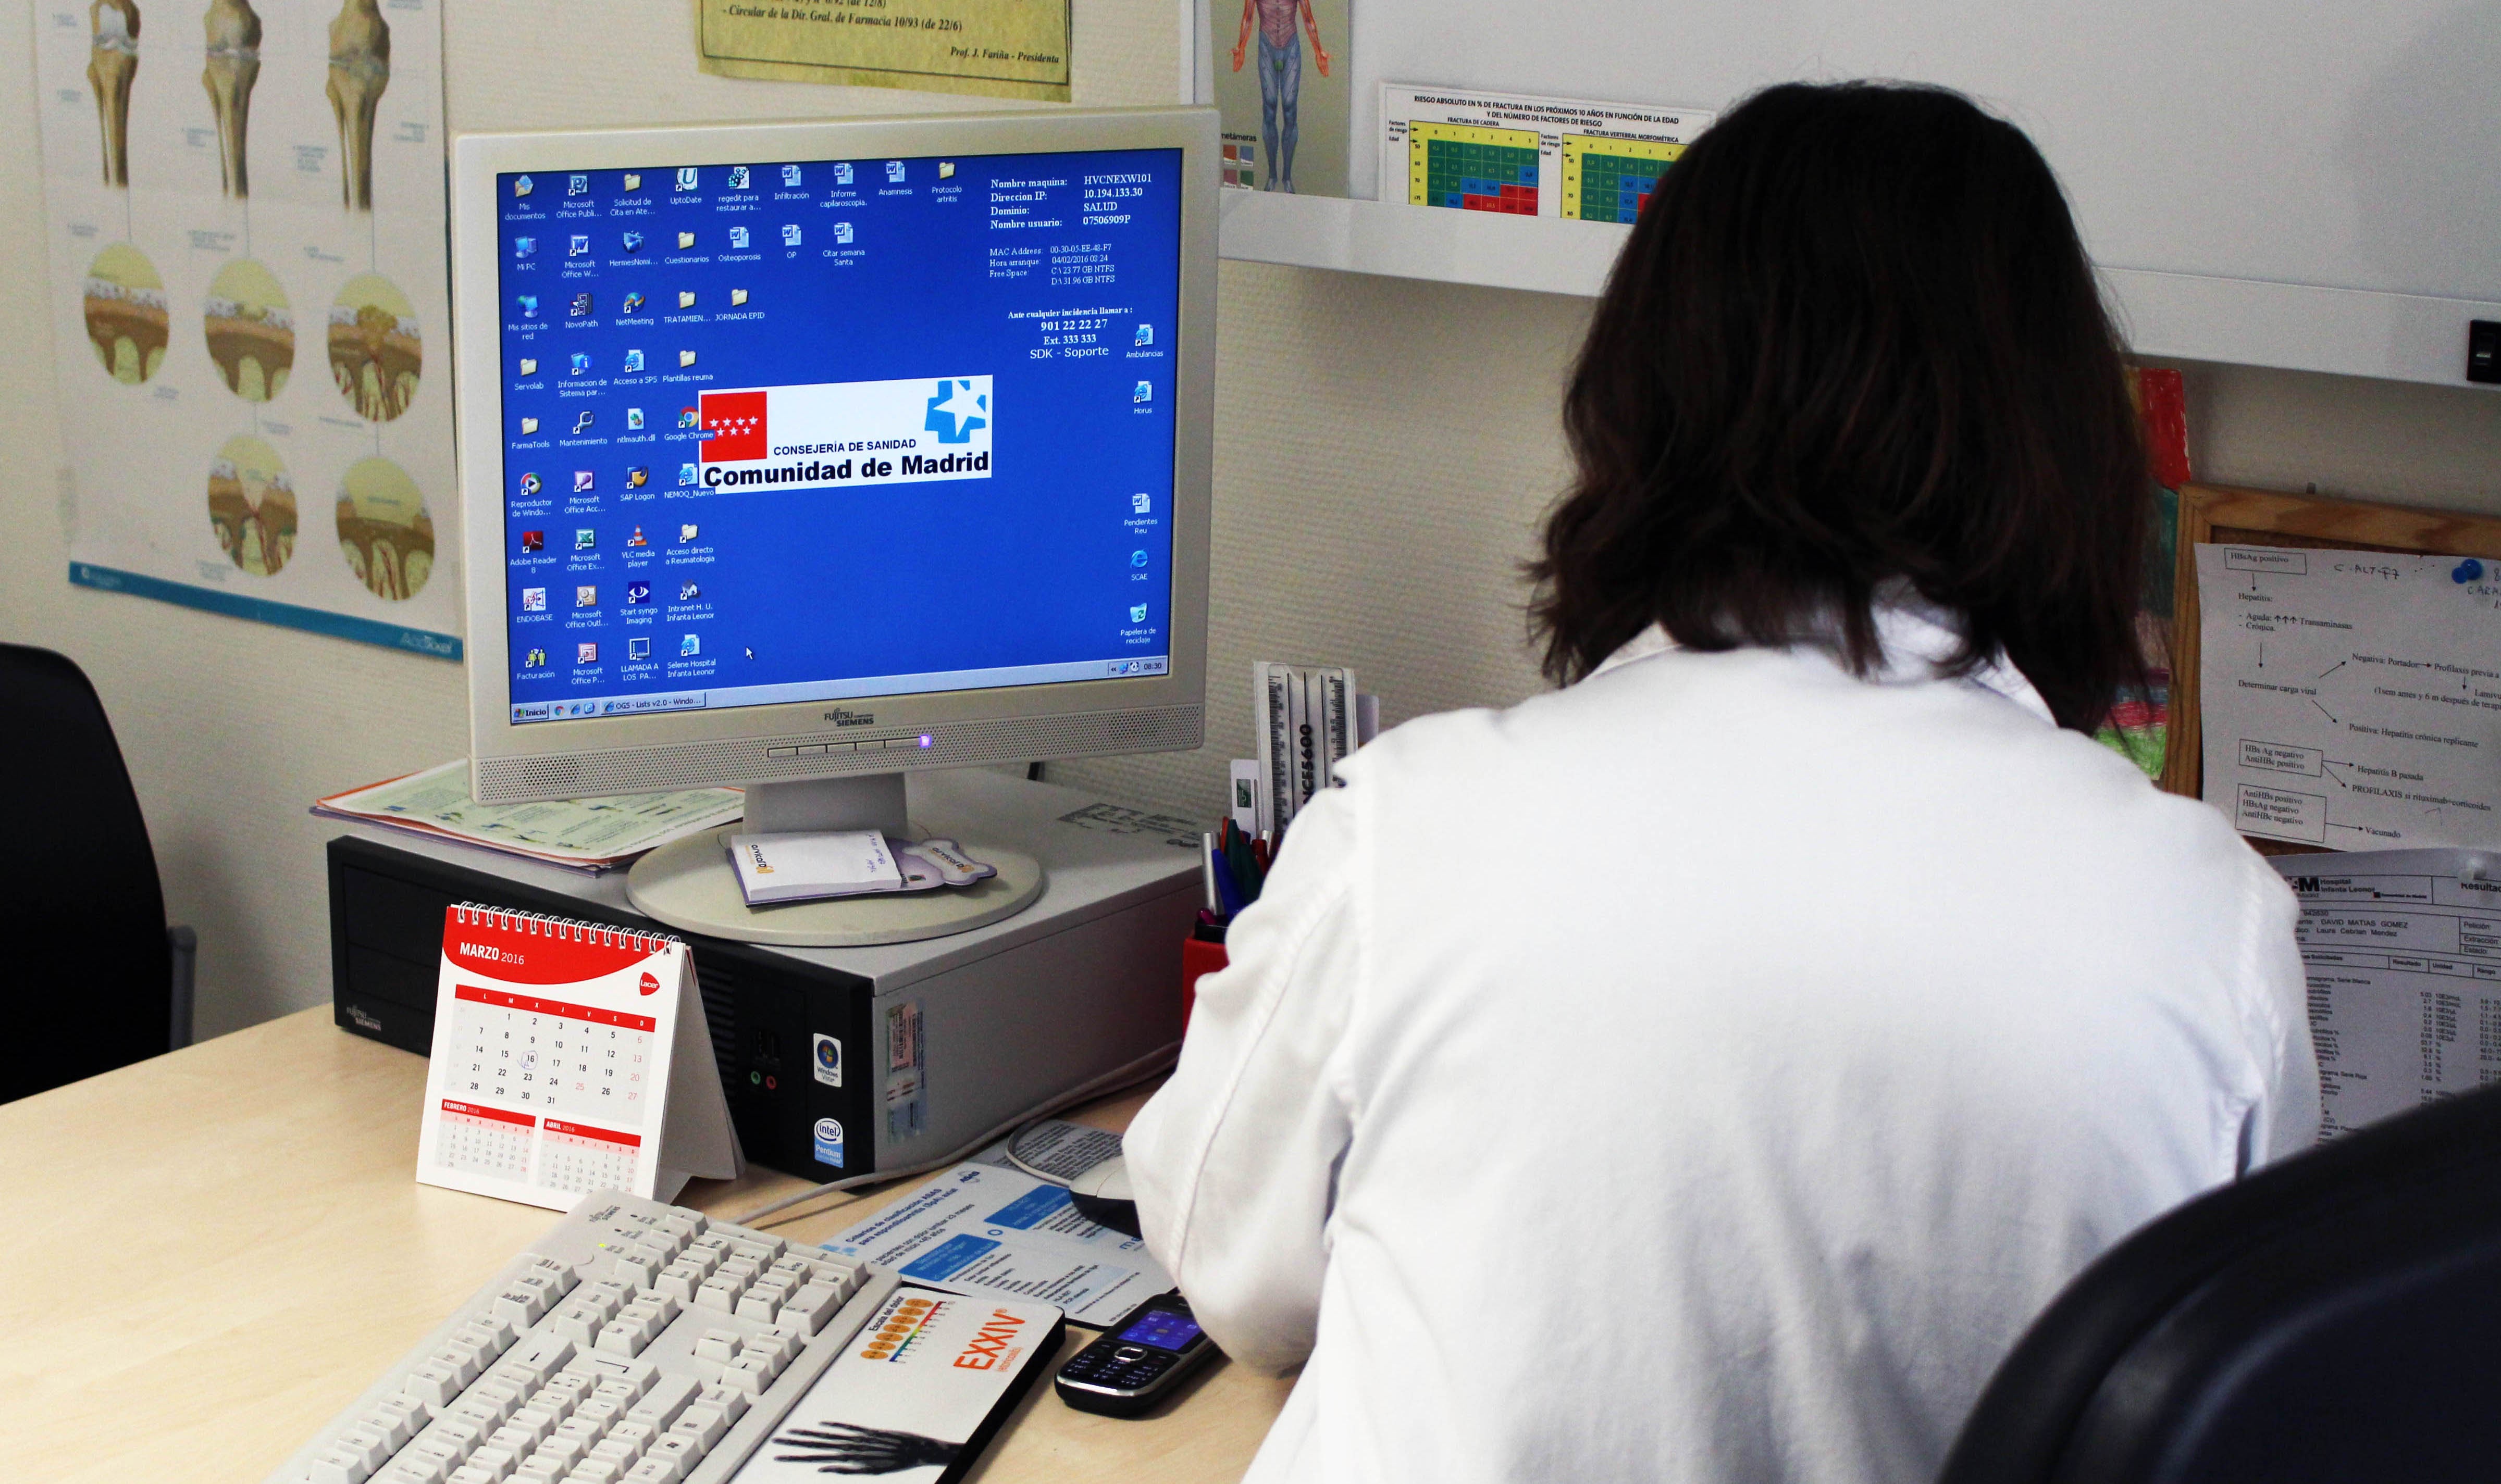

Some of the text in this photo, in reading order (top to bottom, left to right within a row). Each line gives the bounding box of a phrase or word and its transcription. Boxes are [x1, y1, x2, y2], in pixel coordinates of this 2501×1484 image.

[729, 5, 765, 17] Circular
[768, 8, 777, 18] de
[781, 8, 789, 19] la
[835, 12, 845, 23] de
[848, 13, 891, 27] Farmacia
[895, 17, 918, 28] 10/93
[938, 19, 962, 32] 22/6)
[1437, 97, 1467, 106] ABSOLUTO
[1546, 107, 1577, 115] PRÓXIMOS
[1587, 109, 1604, 118] AÑOS
[1615, 113, 1642, 121] FUNCIÓN
[991, 179, 1025, 188] Nombre
[1029, 178, 1067, 188] maquina:
[670, 196, 702, 205] UptoDate
[719, 194, 741, 203] regedit
[991, 188, 1143, 202] Direccion IP: 10.194.133.30
[614, 198, 641, 206] Solicitud
[991, 202, 1117, 215] Dominio: SALUD
[991, 219, 1025, 229] Nombre
[718, 254, 761, 262] Osteoporosis
[715, 313, 747, 321] JORNADA
[565, 320, 598, 328] NovoPath
[1041, 319, 1107, 331] 901 22 22 27
[1044, 334, 1096, 345] Ext. 333 333
[1030, 349, 1053, 359] SDK
[1064, 347, 1109, 358] Soporte
[515, 382, 544, 390] Servolab
[560, 438, 608, 446] Mantenimiento
[617, 434, 655, 443] ntlmauth.dll
[664, 432, 687, 441] Google
[512, 440, 550, 449] FarmaTools
[773, 439, 916, 456] CONSEJERÍA DE SANIDAD
[704, 451, 988, 487] Comunidad de Madrid
[517, 614, 552, 622] ENDOBASE
[690, 658, 716, 667] Hospital
[2238, 680, 2277, 690] Determinar
[2300, 687, 2317, 695] viral
[825, 707, 853, 721] FUJITSU
[836, 718, 874, 727] SIEMENS
[2382, 728, 2413, 739] Hepatitis
[2415, 732, 2441, 743] crónica
[2358, 765, 2389, 776] Hepatitis
[2353, 784, 2403, 799] PROFILAXIS
[2366, 827, 2400, 838] Vacunado
[460, 942, 524, 965] MARZO 2016
[640, 979, 659, 988] Lacer
[581, 1045, 588, 1053] 11
[634, 1054, 642, 1063] 13
[818, 1067, 838, 1078] Windows
[444, 1101, 480, 1115] FEBRERO 2016
[547, 1120, 575, 1133] ABRIL 2016
[820, 1124, 836, 1136] intel
[816, 1146, 840, 1157] Pentium
[869, 1316, 887, 1331] Escala
[954, 1313, 1025, 1369] EXXIV
